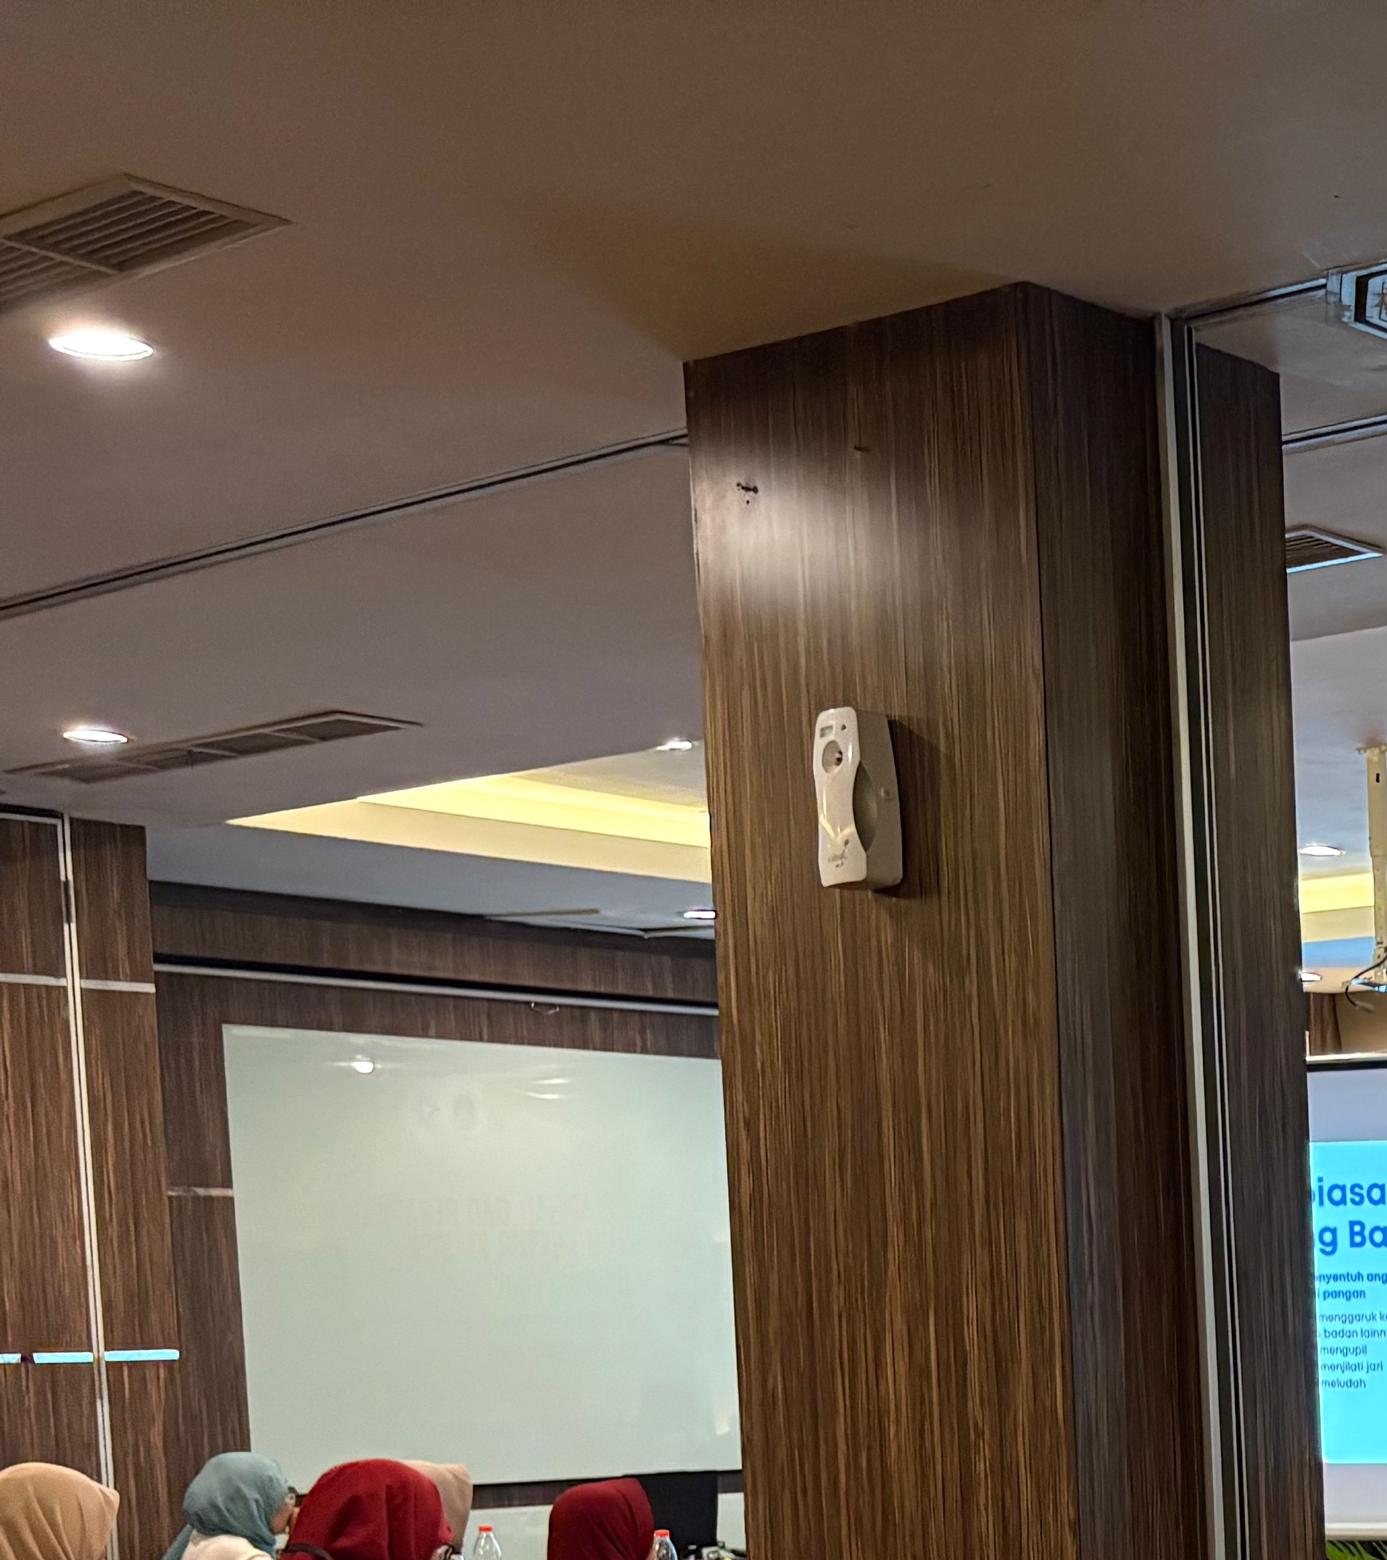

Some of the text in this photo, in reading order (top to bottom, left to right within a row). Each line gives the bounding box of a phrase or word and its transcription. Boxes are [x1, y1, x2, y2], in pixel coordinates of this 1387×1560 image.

[1316, 1270, 1364, 1284] nyentuh
[1322, 1288, 1367, 1301] pangan
[1323, 1328, 1358, 1339] badan
